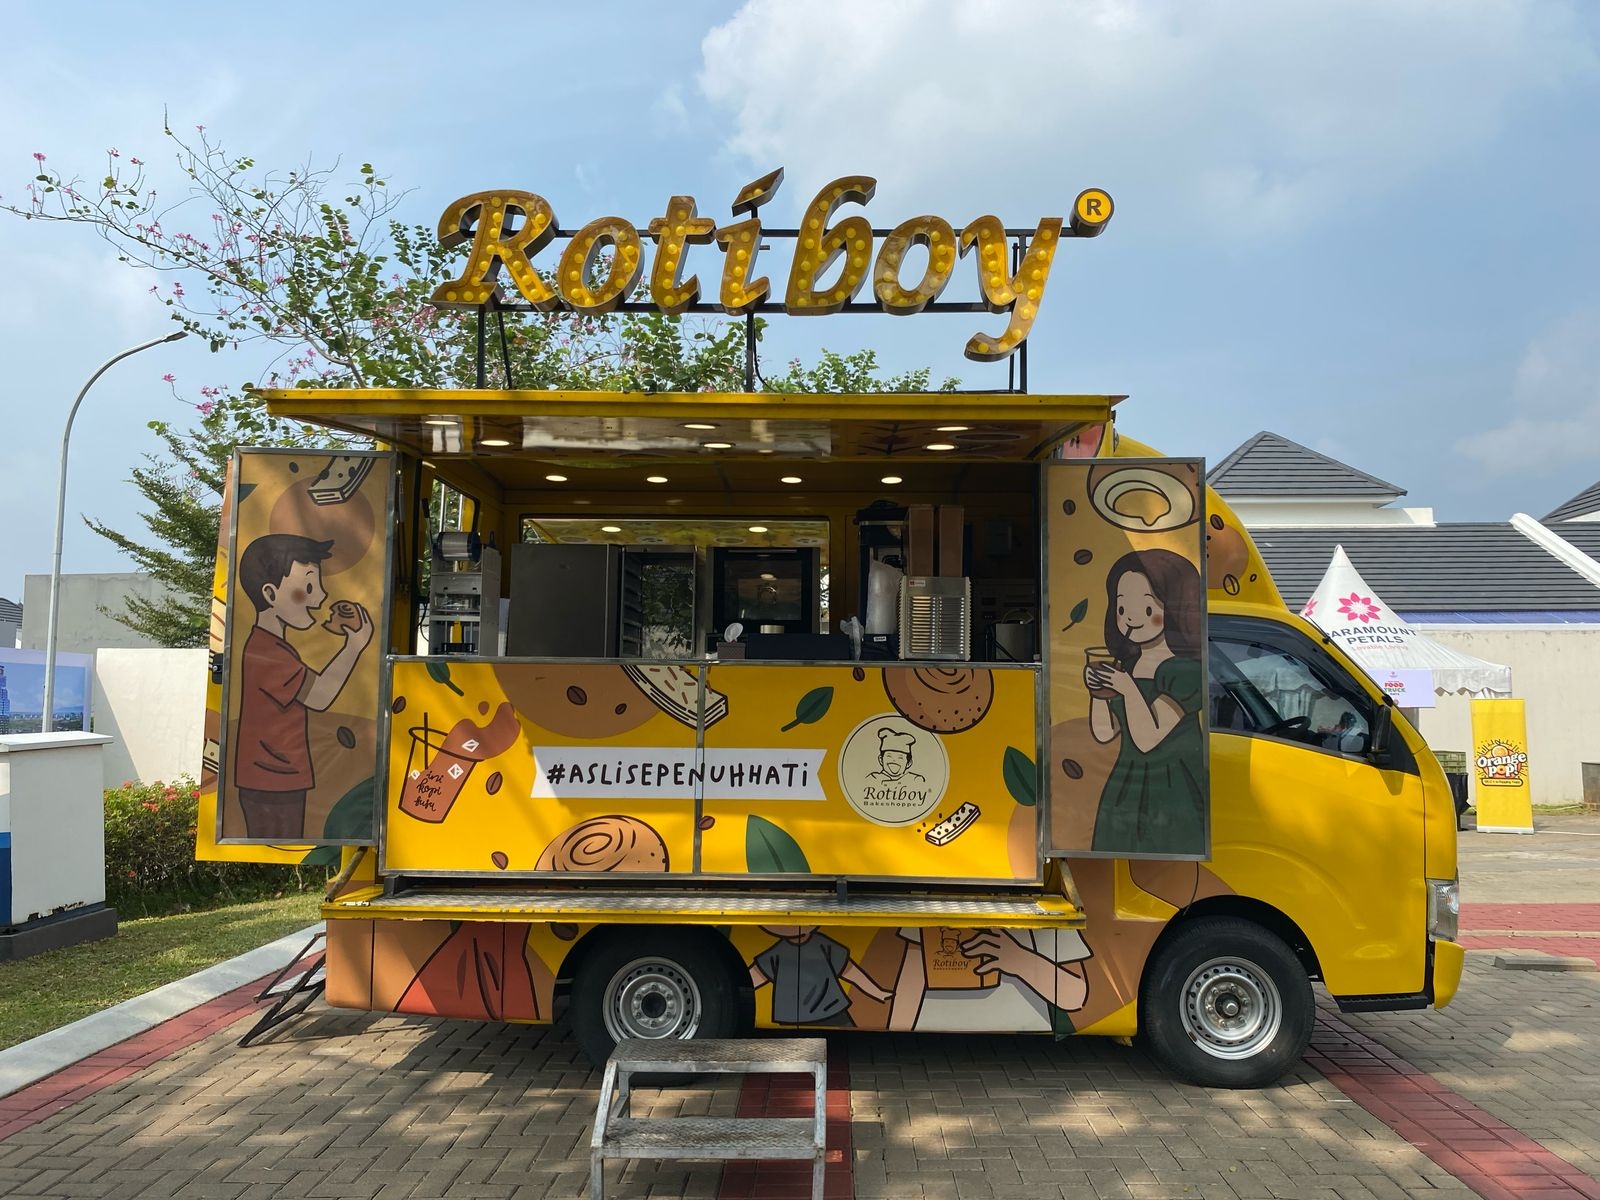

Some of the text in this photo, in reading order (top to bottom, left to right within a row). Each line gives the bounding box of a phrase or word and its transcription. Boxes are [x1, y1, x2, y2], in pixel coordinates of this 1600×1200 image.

[433, 167, 1064, 362] Rotiboy
[1346, 635, 1404, 645] PETALS
[1477, 752, 1527, 768] Orange
[863, 785, 927, 806] Rotiboy
[932, 959, 969, 969] Rotiboy
